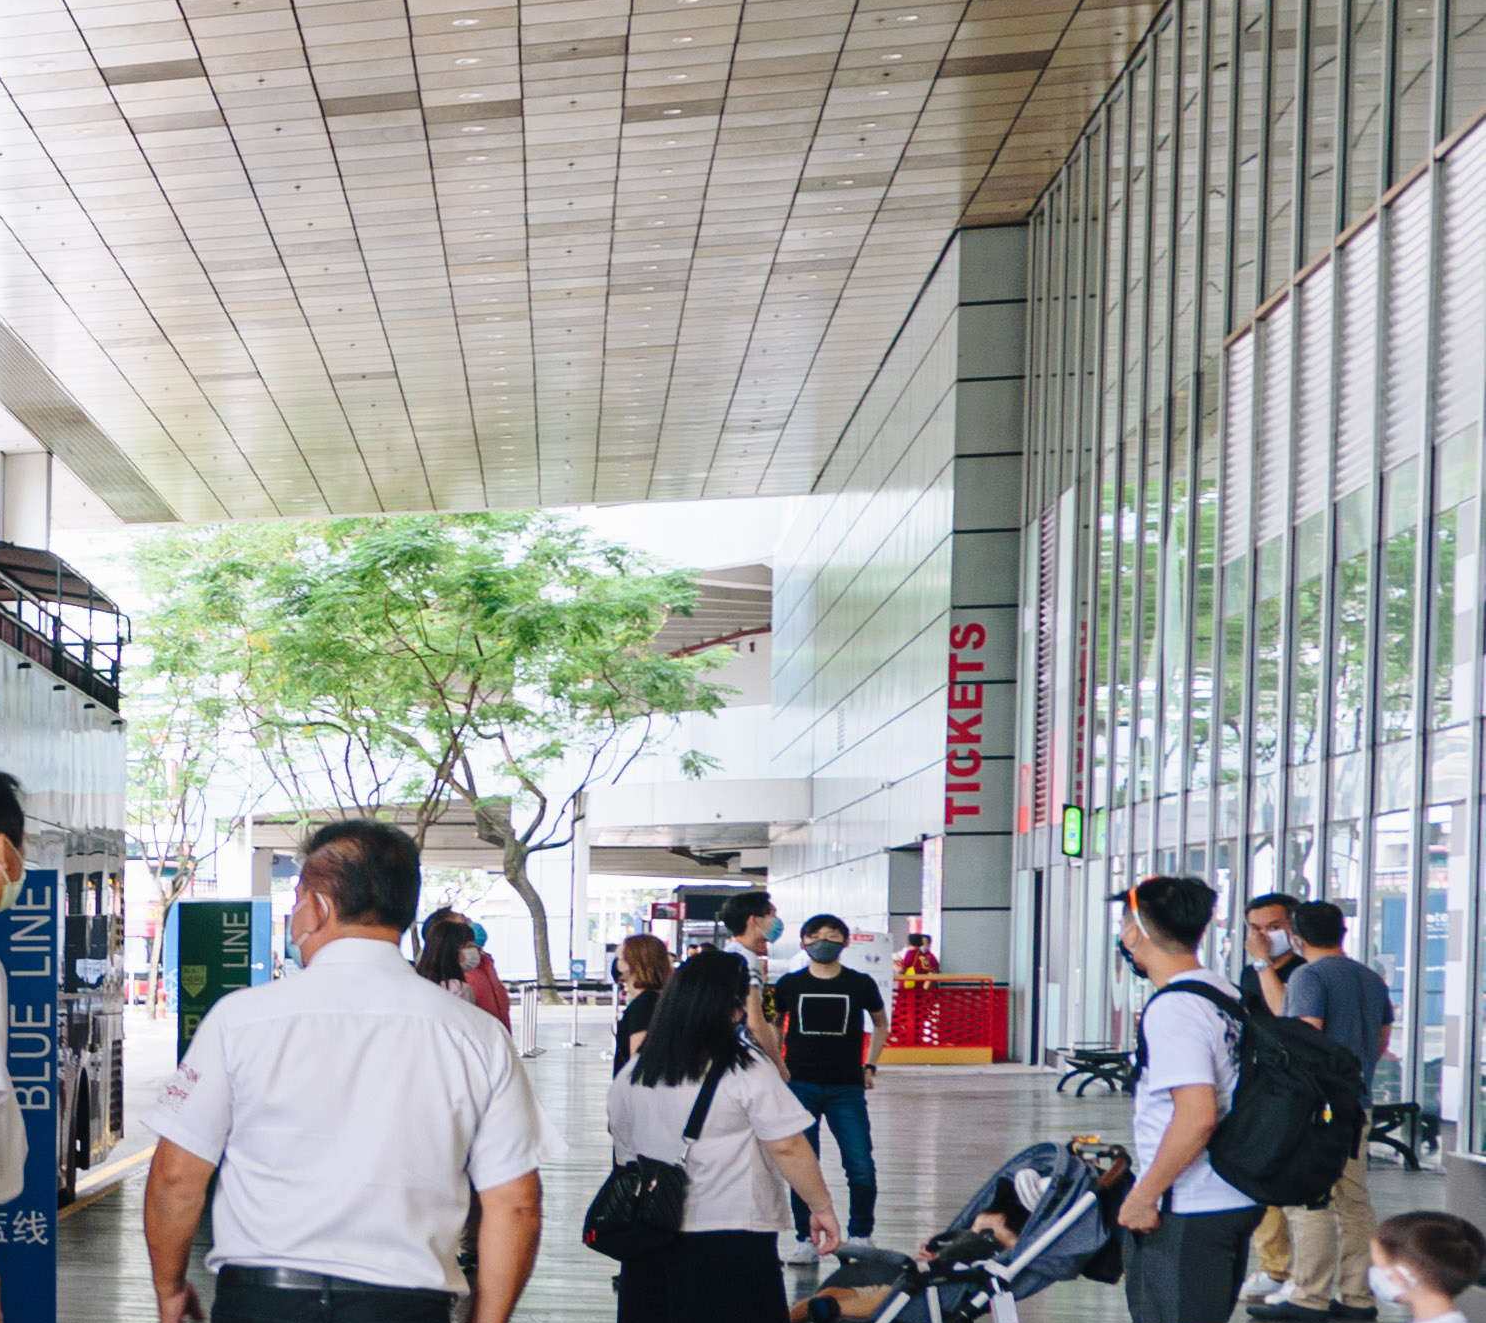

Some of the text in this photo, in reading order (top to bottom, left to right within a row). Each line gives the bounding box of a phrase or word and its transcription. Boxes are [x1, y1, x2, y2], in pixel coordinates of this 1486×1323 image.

[944, 622, 986, 826] TICKETS
[9, 885, 51, 1111] BLUE LINE
[222, 911, 249, 968] LINE
